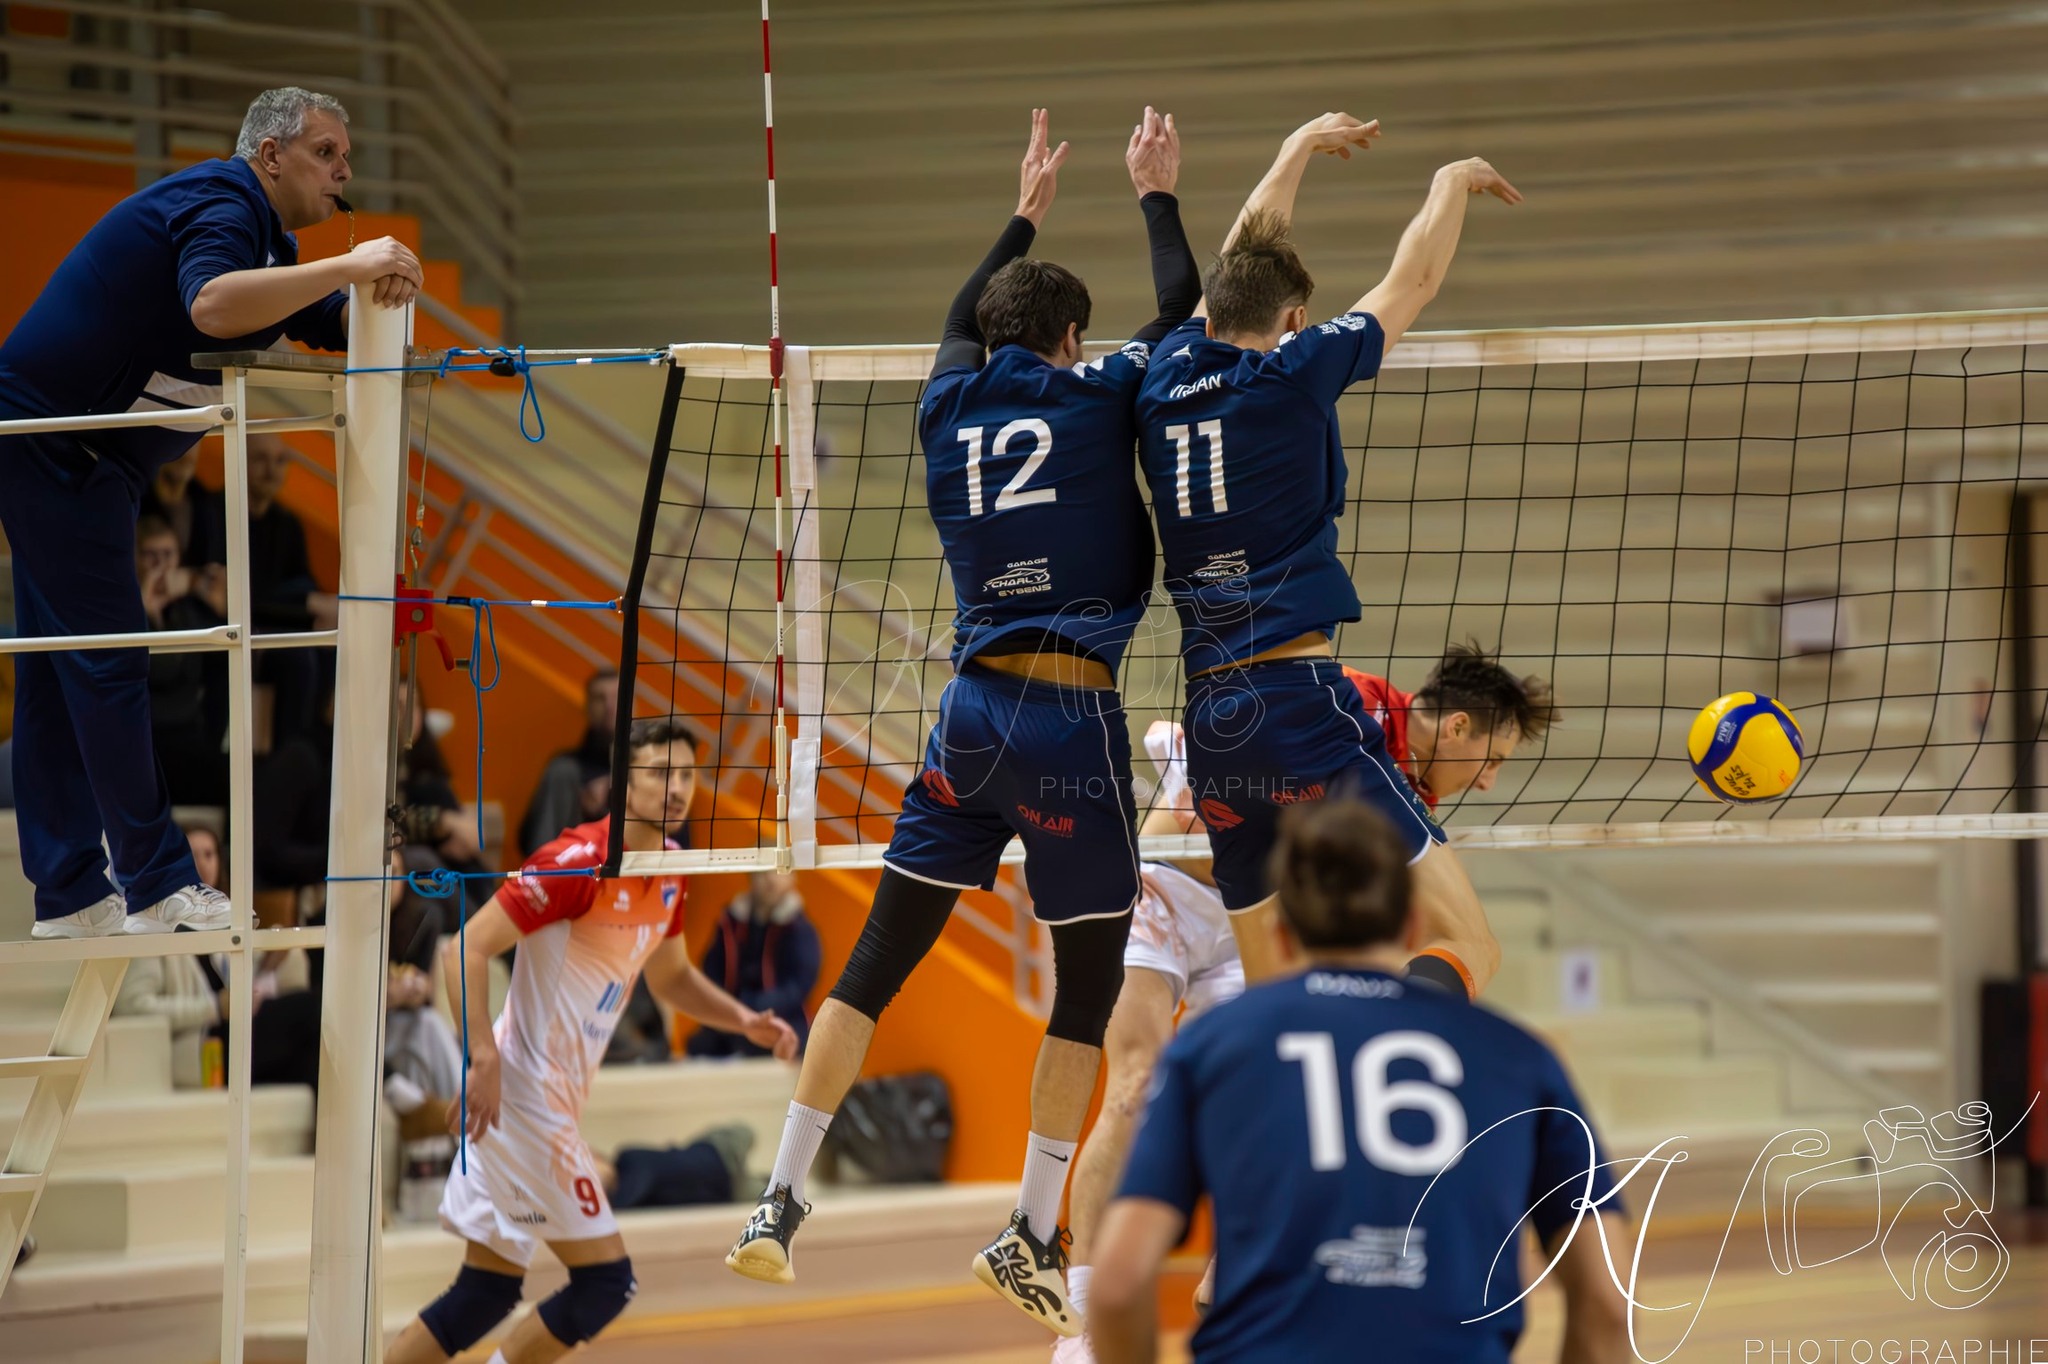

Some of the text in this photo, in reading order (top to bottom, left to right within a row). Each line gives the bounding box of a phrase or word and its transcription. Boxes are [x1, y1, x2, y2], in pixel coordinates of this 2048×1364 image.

[957, 418, 1057, 516] 12
[1165, 418, 1228, 517] 11
[1006, 557, 1049, 569] GARAGE
[1207, 549, 1246, 561] GARAGE
[1197, 566, 1244, 577] CHARLY
[991, 574, 1045, 588] CHARLY
[998, 583, 1052, 597] EYBENS
[1016, 803, 1041, 826] ON
[1276, 1030, 1469, 1177] 16
[574, 1176, 601, 1217] 9
